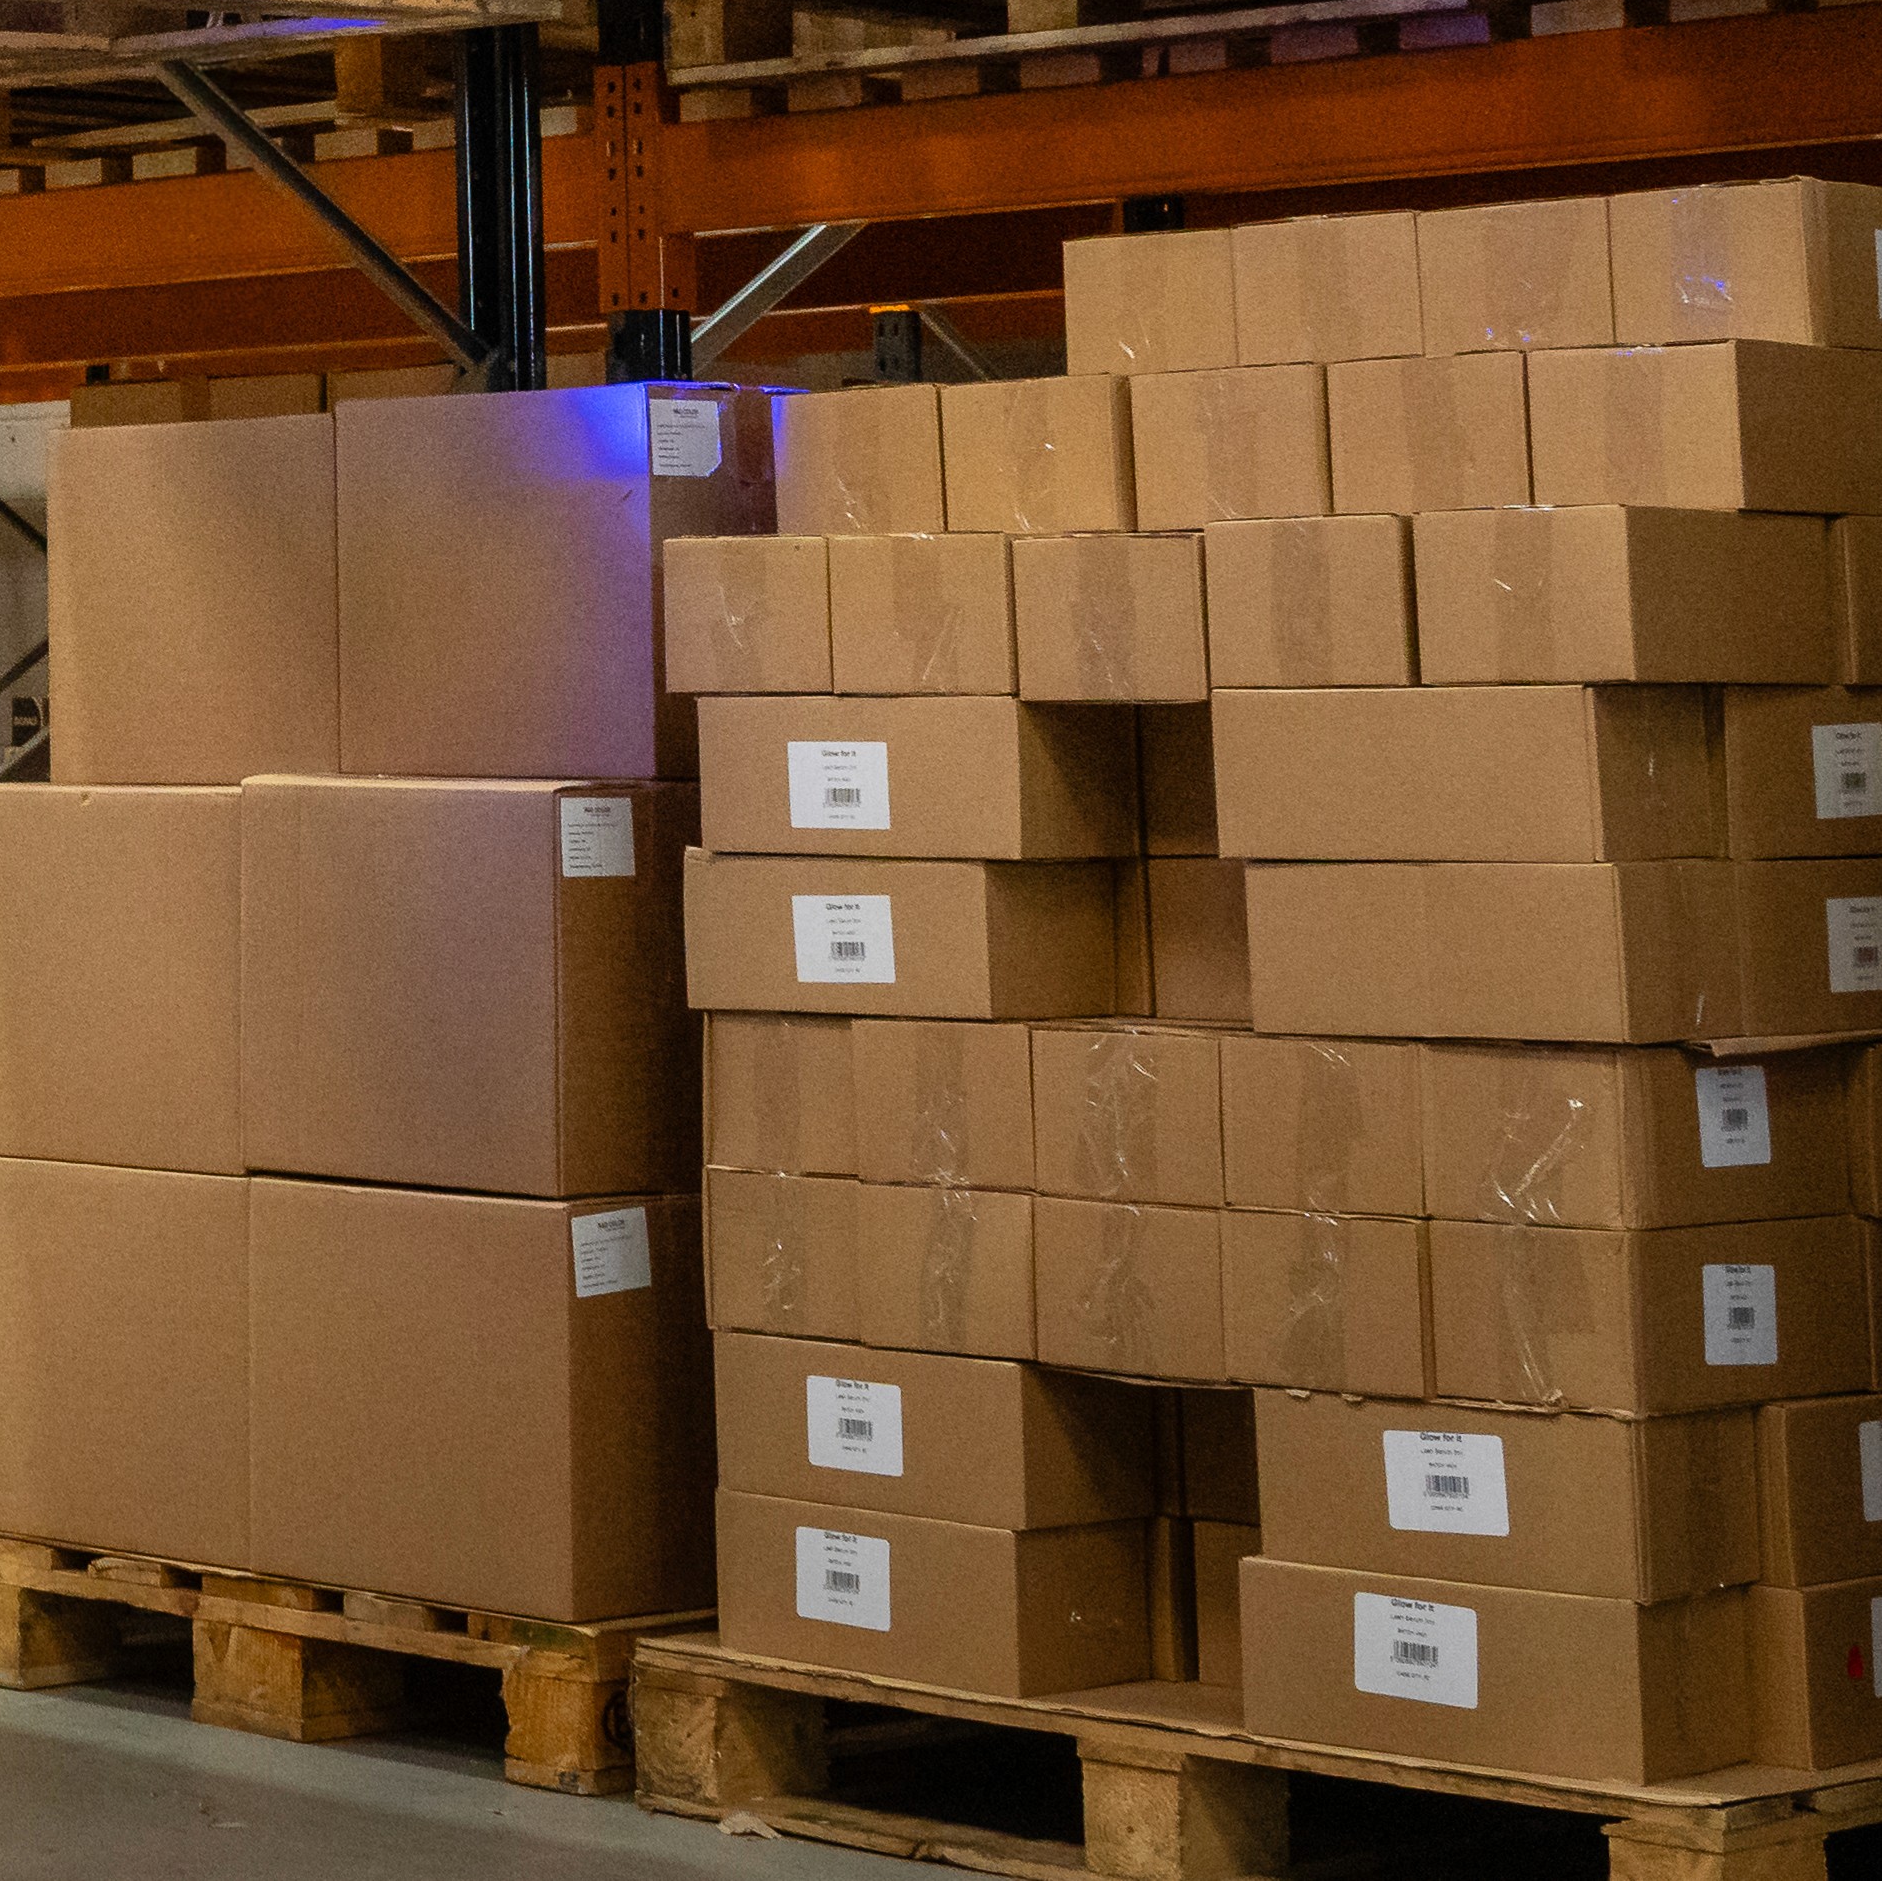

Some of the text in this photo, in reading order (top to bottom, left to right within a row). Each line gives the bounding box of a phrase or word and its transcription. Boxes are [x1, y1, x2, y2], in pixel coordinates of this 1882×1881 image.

[1420, 1432, 1440, 1441] Glow
[1391, 1599, 1412, 1608] Glow
[1415, 1602, 1426, 1610] for
